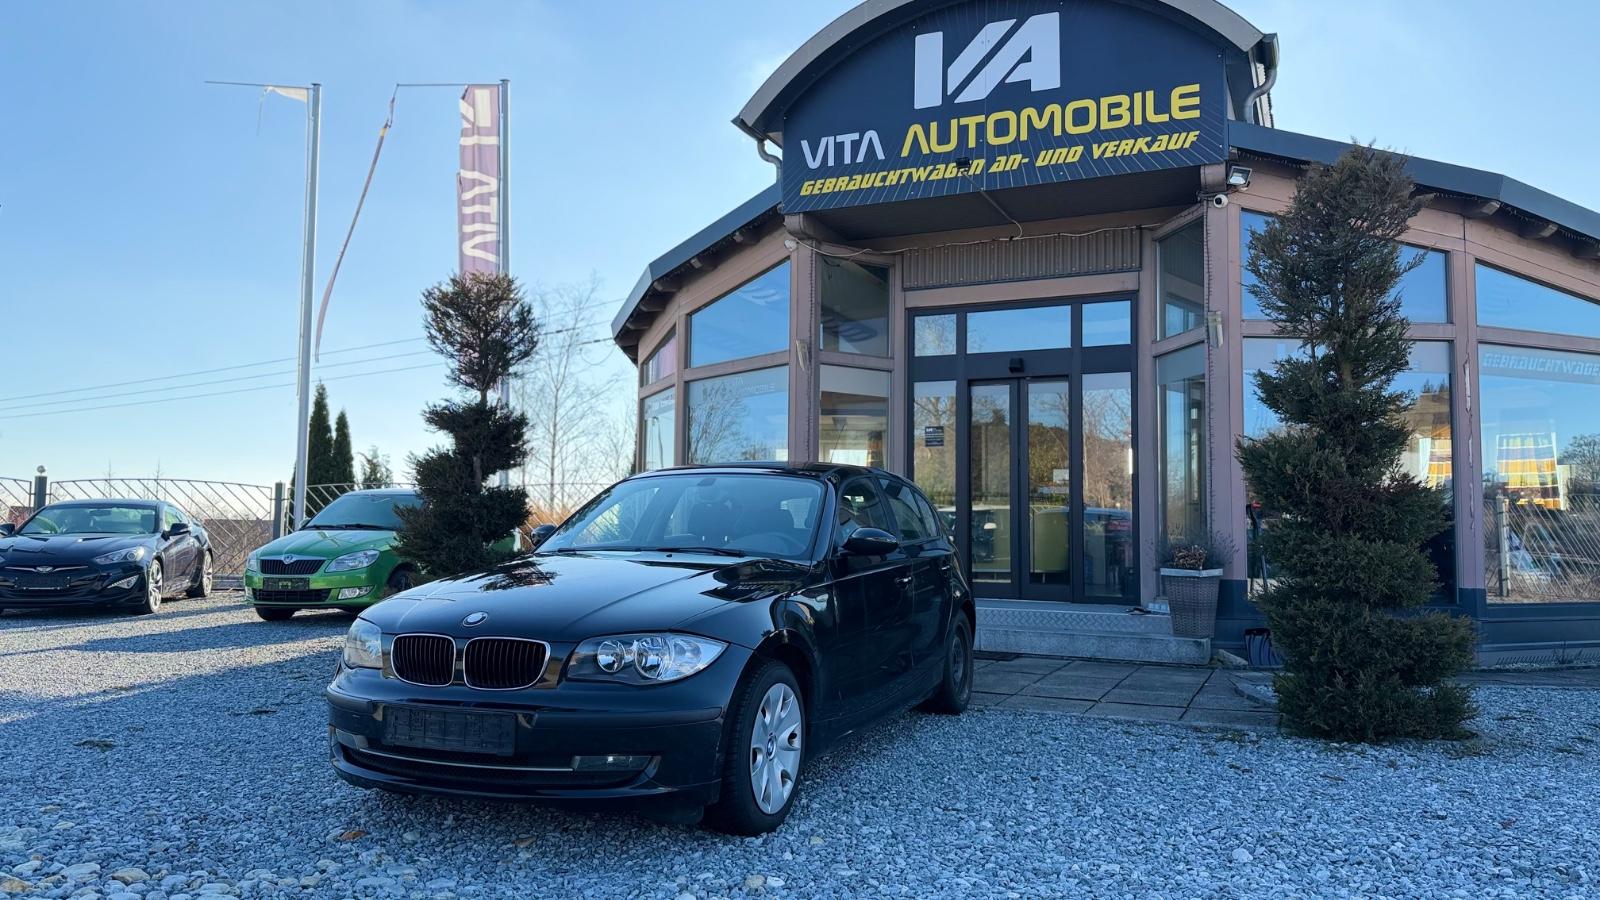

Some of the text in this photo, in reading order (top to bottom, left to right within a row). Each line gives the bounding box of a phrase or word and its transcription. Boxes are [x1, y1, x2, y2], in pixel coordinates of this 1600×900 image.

[800, 83, 1201, 170] VITA AUTOMOBILE
[987, 154, 1031, 174] AN-
[1035, 145, 1083, 169] UND
[1089, 130, 1200, 160] VERKAUF
[1482, 352, 1600, 377] GEBRAUCHTWAGE
